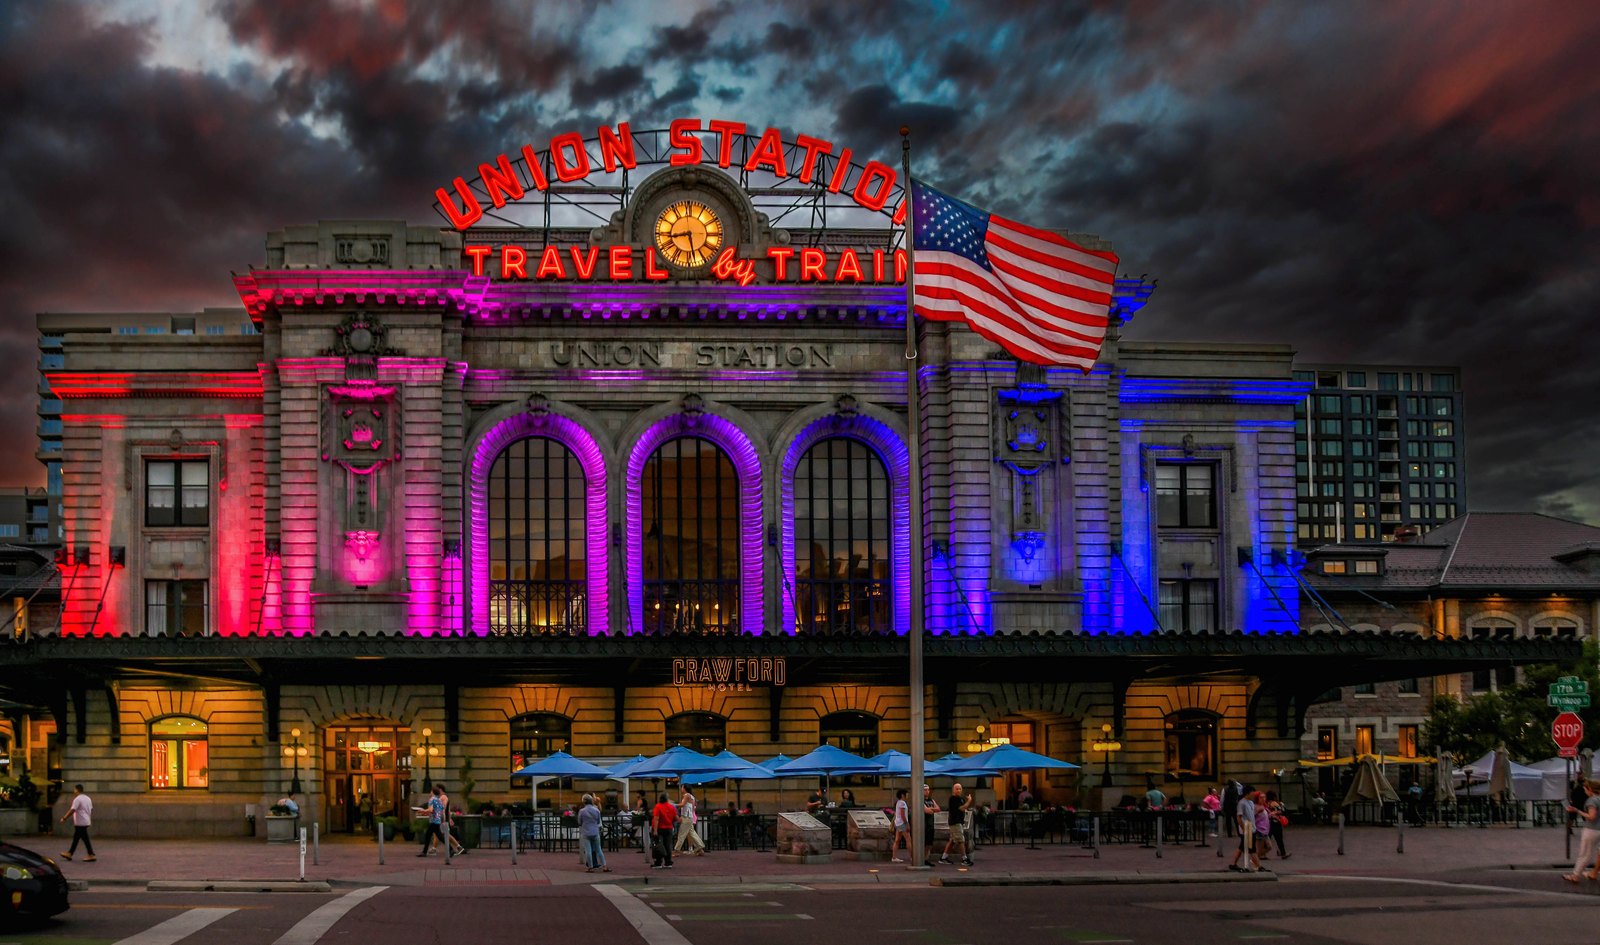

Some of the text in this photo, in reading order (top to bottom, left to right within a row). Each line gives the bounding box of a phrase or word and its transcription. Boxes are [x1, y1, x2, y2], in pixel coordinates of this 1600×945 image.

[435, 122, 636, 230] UNION
[465, 245, 668, 280] TRAVEL
[712, 246, 756, 287] by
[551, 344, 832, 367] UNION STATION
[672, 658, 786, 686] CRAWFORD
[707, 683, 753, 692] HOTEL
[1556, 684, 1574, 693] 17th
[1554, 724, 1581, 738] STOP
